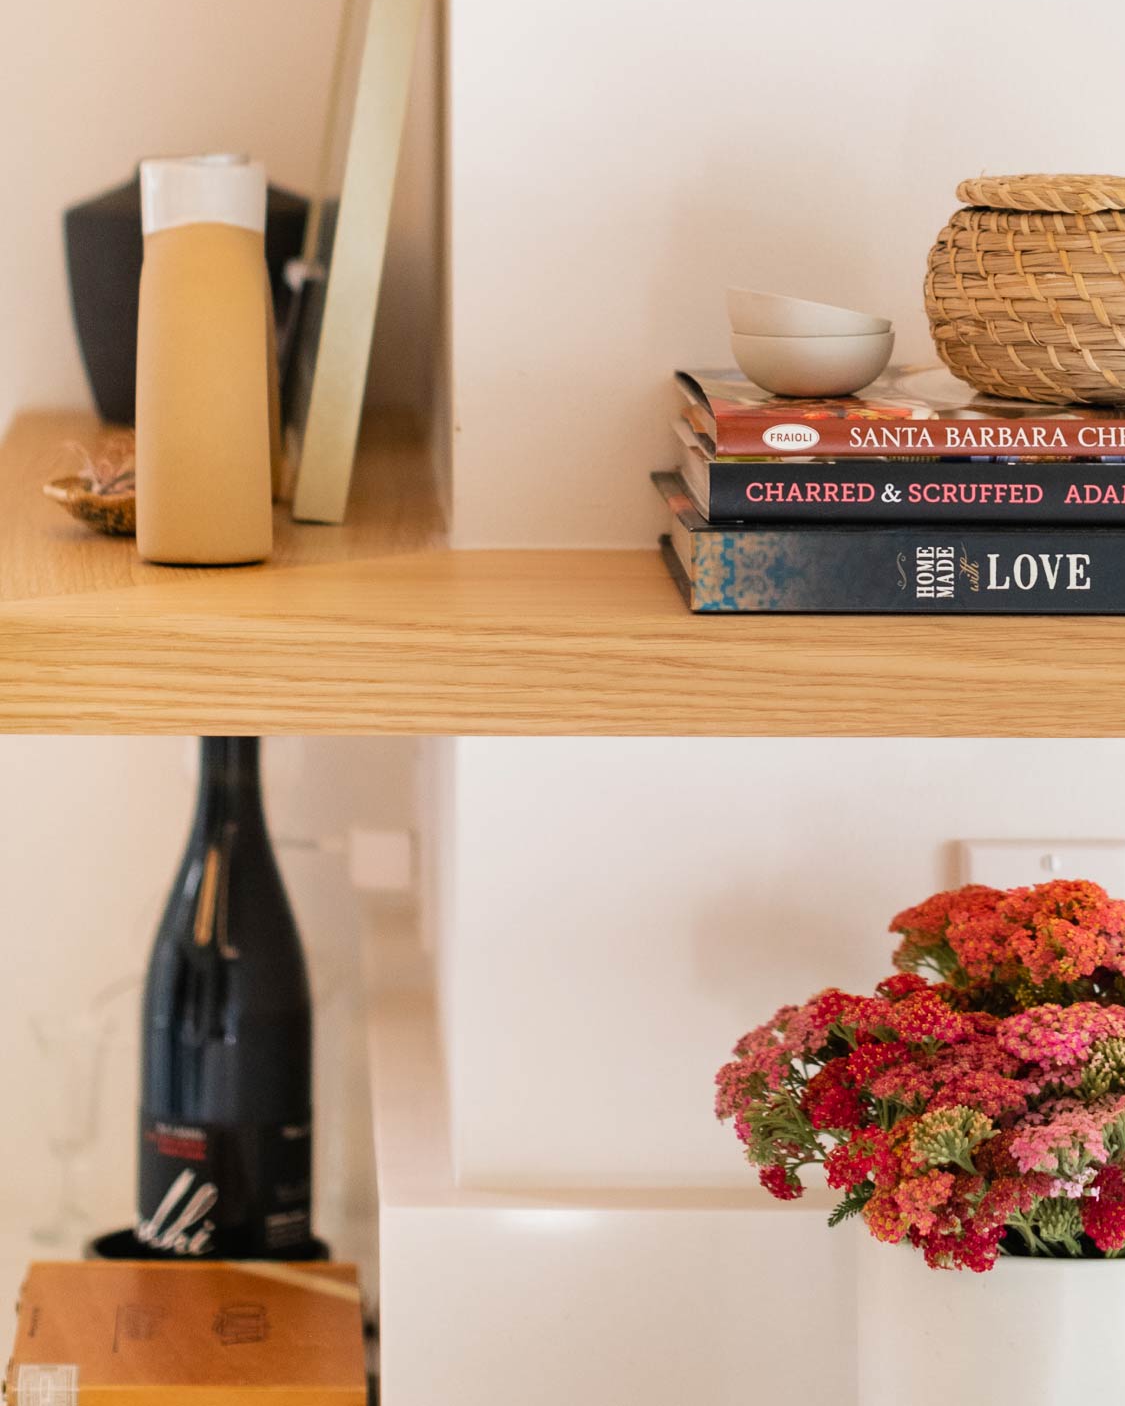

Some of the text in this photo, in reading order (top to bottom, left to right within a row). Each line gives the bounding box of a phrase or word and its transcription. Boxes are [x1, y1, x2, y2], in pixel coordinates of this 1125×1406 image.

[769, 431, 813, 444] FRAIOLI
[849, 426, 934, 448] SANTA
[945, 426, 1068, 448] BARBARA
[745, 482, 1043, 504] CHARRED & SCRUFFED
[916, 546, 935, 599] HOME
[936, 546, 955, 599] MADE
[959, 542, 979, 592] with
[986, 553, 1091, 591] LOVE
